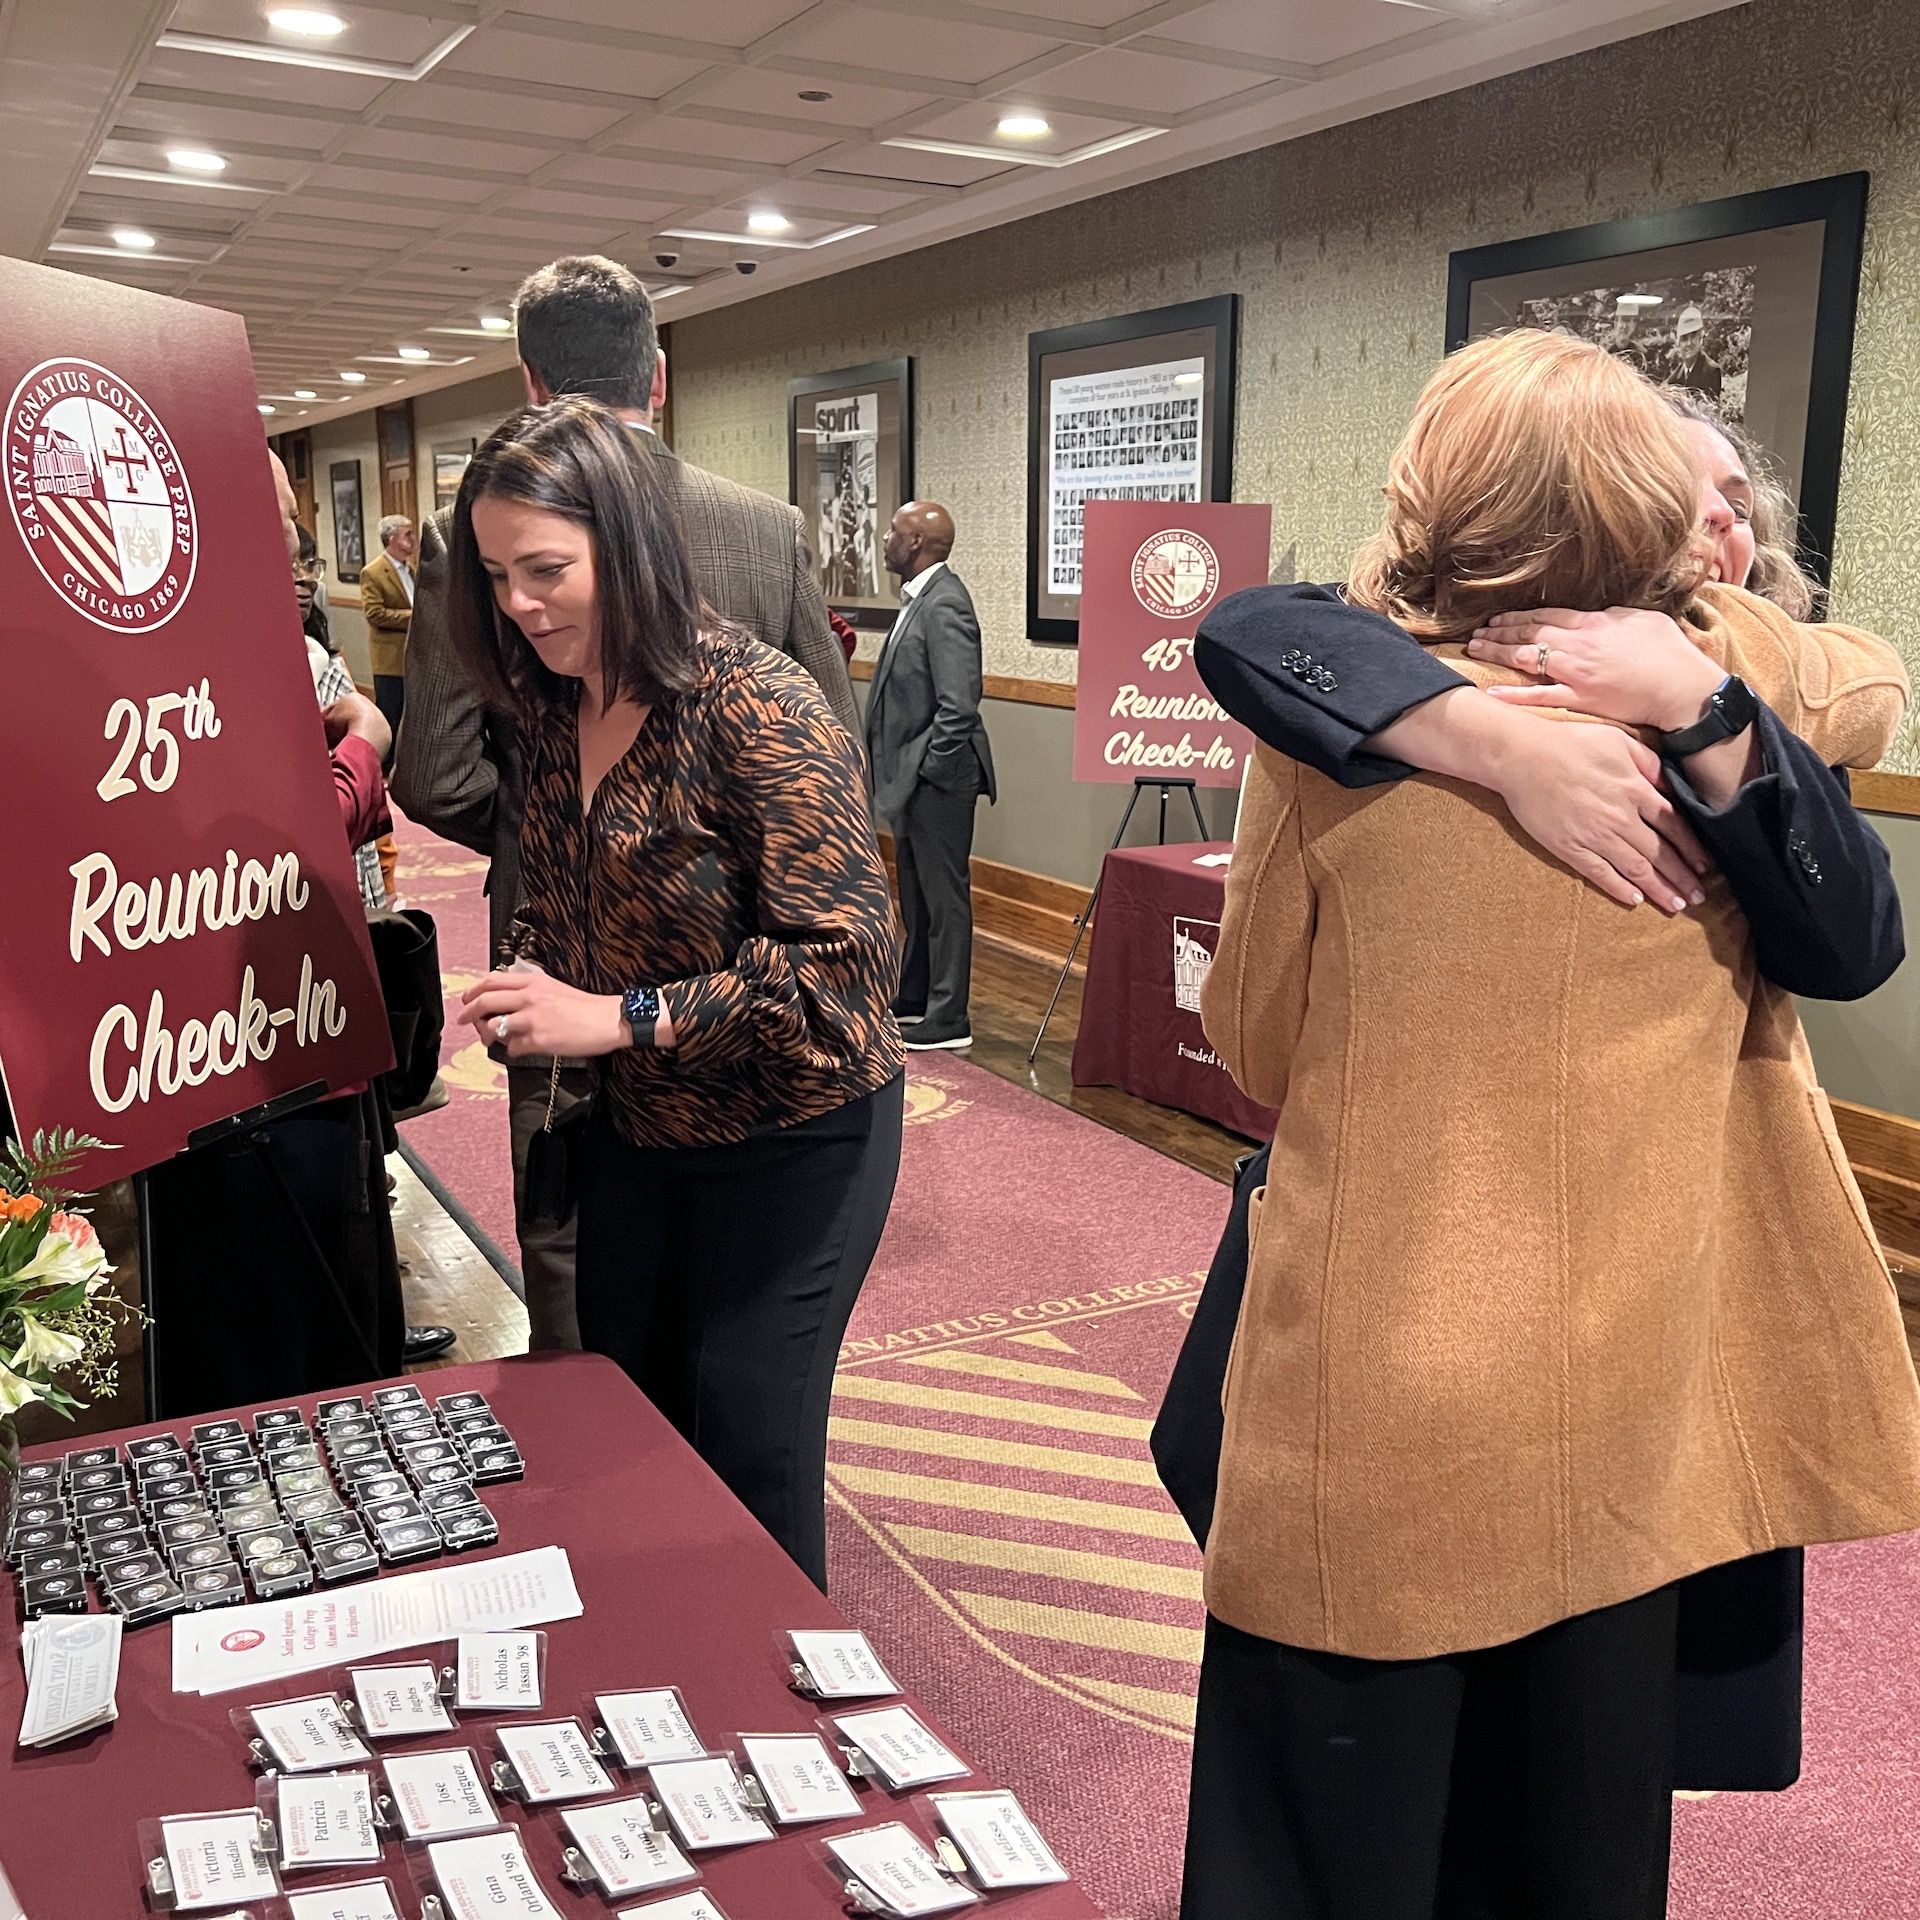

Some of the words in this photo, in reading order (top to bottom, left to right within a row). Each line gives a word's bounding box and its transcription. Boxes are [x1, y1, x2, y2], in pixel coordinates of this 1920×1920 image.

[23, 371, 91, 444] IGNATIUS
[96, 378, 176, 477] COLLEGE
[11, 446, 45, 540] SAINT
[170, 486, 191, 555] PREP
[1135, 559, 1144, 589] SAINT
[1141, 533, 1180, 559] IGNATIUS
[1182, 535, 1214, 566] COLLEGE
[62, 571, 145, 620] CHICAGO
[149, 574, 179, 613] 1869
[1110, 684, 1230, 721] Reunion
[96, 678, 222, 802] 25th
[1103, 731, 1235, 769] Check-In
[68, 849, 310, 963] Reunion
[89, 953, 346, 1113] Check-In
[1012, 1275, 1193, 1321] COLLEGE
[281, 1610, 296, 1637] Ignatius
[303, 1609, 318, 1624] Prep
[323, 1603, 335, 1622] Medal
[345, 1606, 361, 1637] Recipients
[281, 1639, 293, 1656] Saint
[304, 1625, 318, 1650] College
[324, 1624, 338, 1648] Alumni
[516, 1646, 528, 1659] '98
[834, 1648, 859, 1680] Natasha
[851, 1648, 865, 1660] '98
[495, 1649, 508, 1690] Nicholas
[519, 1663, 530, 1694] Yassan
[859, 1661, 879, 1679] Solis
[384, 1691, 402, 1712] Trish
[408, 1687, 423, 1712] Hughes
[317, 1708, 333, 1720] '98
[304, 1719, 327, 1745] Anders
[324, 1720, 356, 1750] Watson
[560, 1730, 575, 1742] '98
[634, 1717, 654, 1742] Annie
[658, 1719, 674, 1738] Cella
[542, 1742, 573, 1778] Micheal
[570, 1744, 601, 1784] Seraphin
[812, 1760, 823, 1773] '98
[453, 1766, 482, 1815] Rodriguez
[793, 1765, 817, 1789] Julio
[822, 1775, 840, 1792] Paz
[354, 1791, 365, 1803] '98
[436, 1783, 456, 1803] Jose
[694, 1794, 716, 1819] Sofia
[310, 1800, 329, 1841] Patricia
[336, 1810, 349, 1830] Avila
[357, 1805, 372, 1846] Rodriguez
[621, 1815, 644, 1831] '97
[998, 1807, 1016, 1822] '98
[612, 1835, 634, 1859] Sean
[988, 1822, 1022, 1861] Melissa
[1012, 1824, 1052, 1872] Martinez
[199, 1841, 221, 1884] Victoria
[225, 1841, 246, 1879] Hinsdale
[502, 1853, 518, 1872] '98
[880, 1862, 916, 1889] Emily
[486, 1876, 506, 1903] Gina
[509, 1874, 542, 1912] Orland
